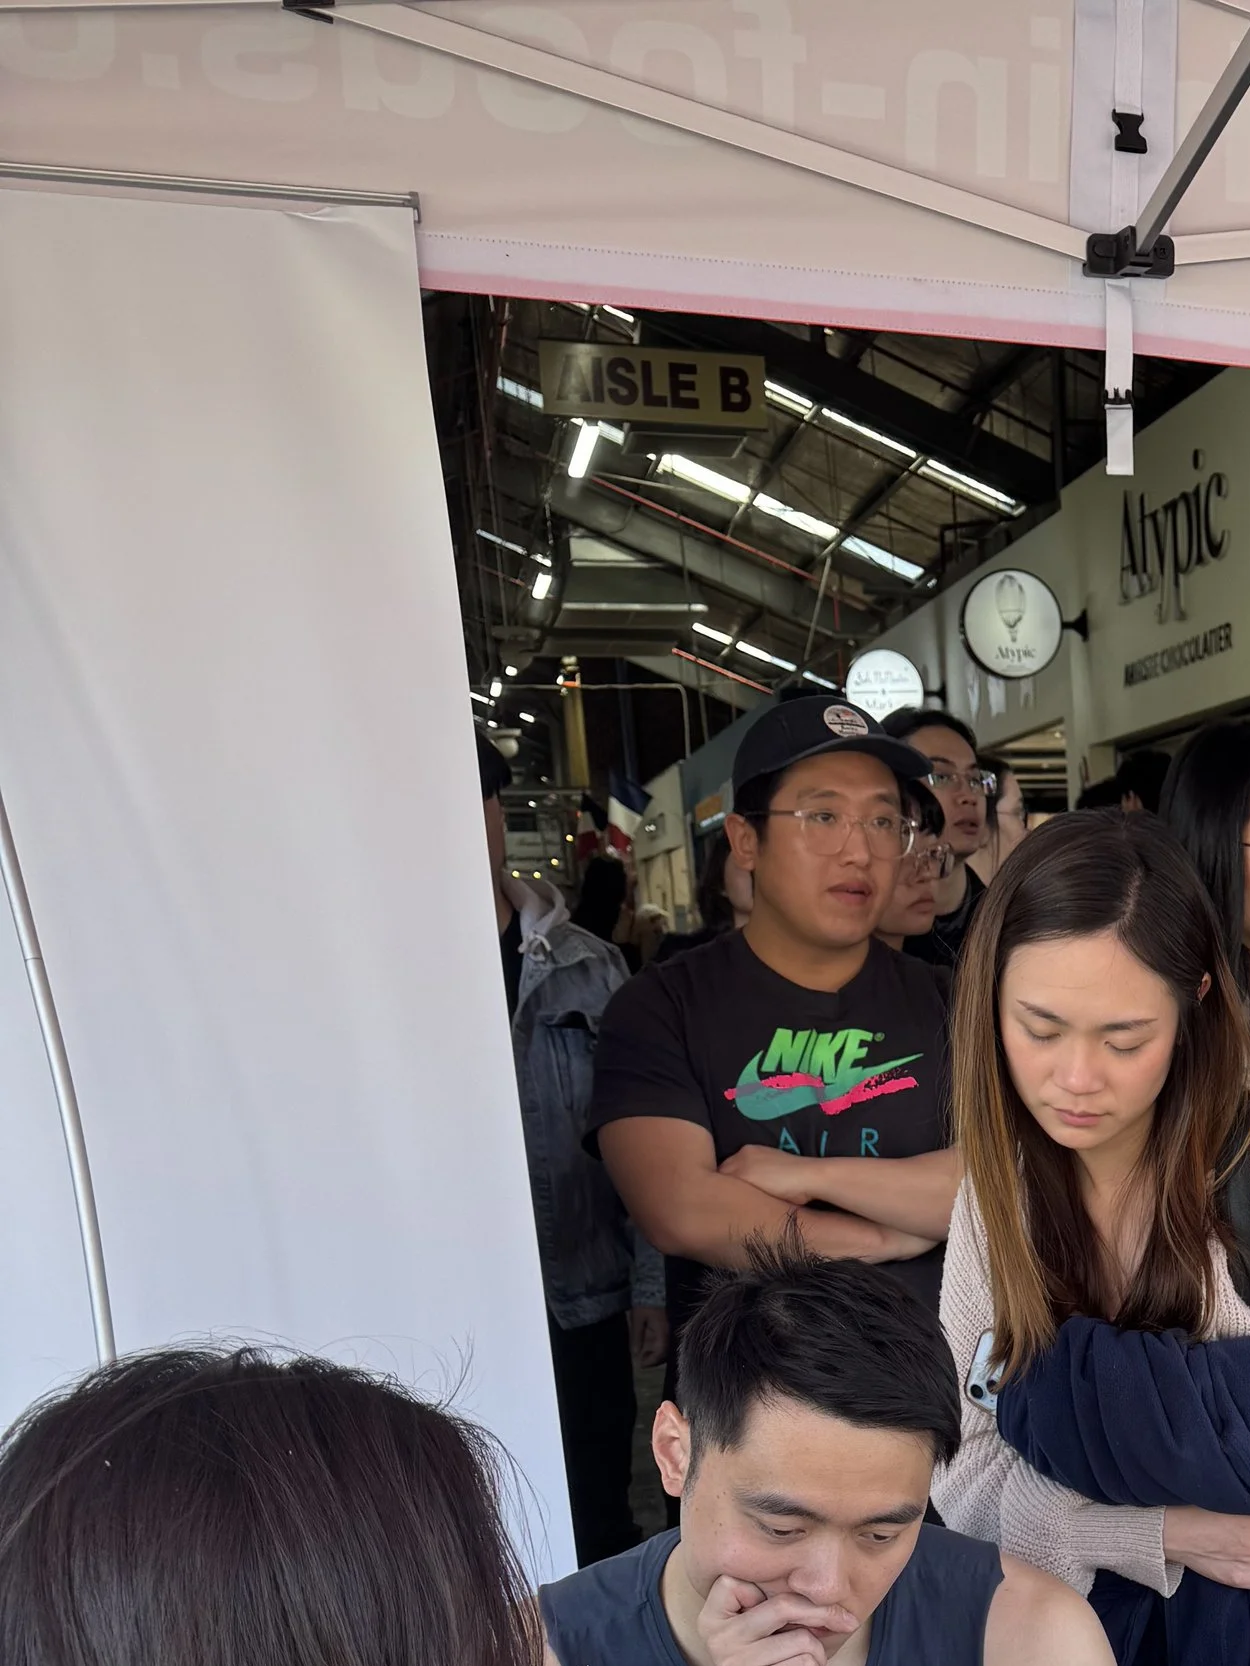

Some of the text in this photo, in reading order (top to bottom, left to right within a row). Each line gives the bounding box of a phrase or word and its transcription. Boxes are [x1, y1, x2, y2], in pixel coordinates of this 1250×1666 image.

[556, 355, 753, 413] AISLE B
[1119, 448, 1230, 625] Atypic
[761, 1027, 874, 1086] NIKE
[778, 1127, 879, 1157] AIR
